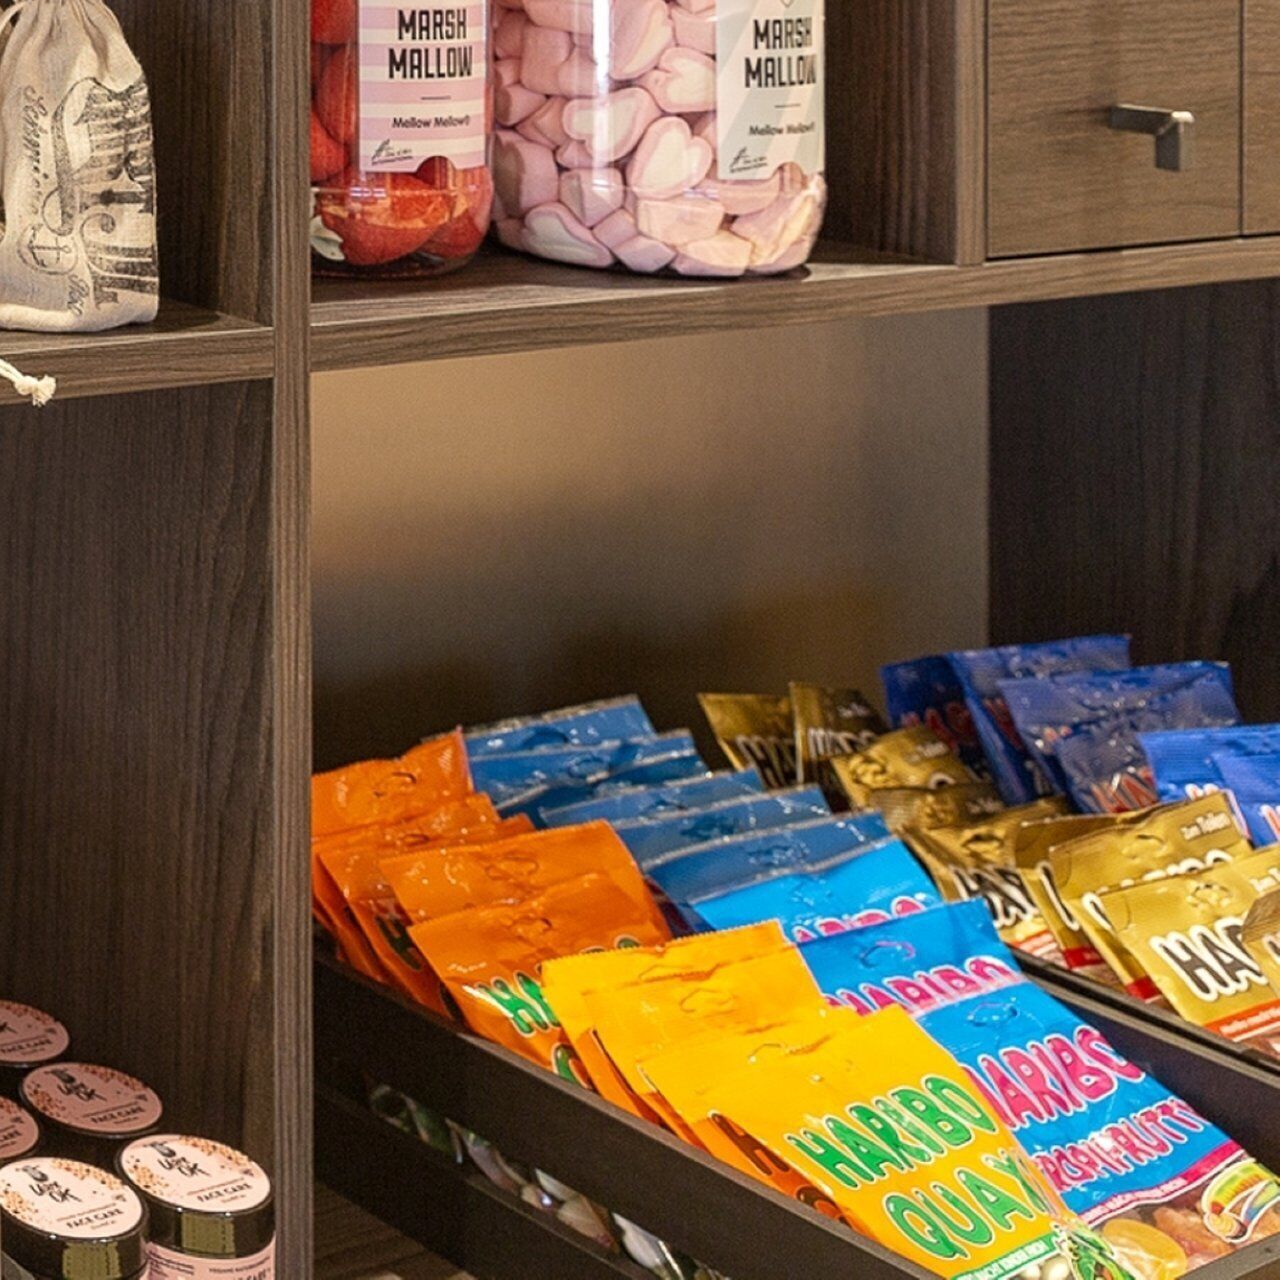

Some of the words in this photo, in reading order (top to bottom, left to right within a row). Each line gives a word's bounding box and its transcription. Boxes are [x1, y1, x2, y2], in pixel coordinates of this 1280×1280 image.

[398, 8, 467, 41] MARSH
[753, 17, 813, 50] MARSH
[389, 47, 473, 79] MALLOW
[744, 53, 817, 88] MALLOW
[787, 1077, 997, 1188] HARIBO
[885, 1150, 1047, 1258] QUAX
